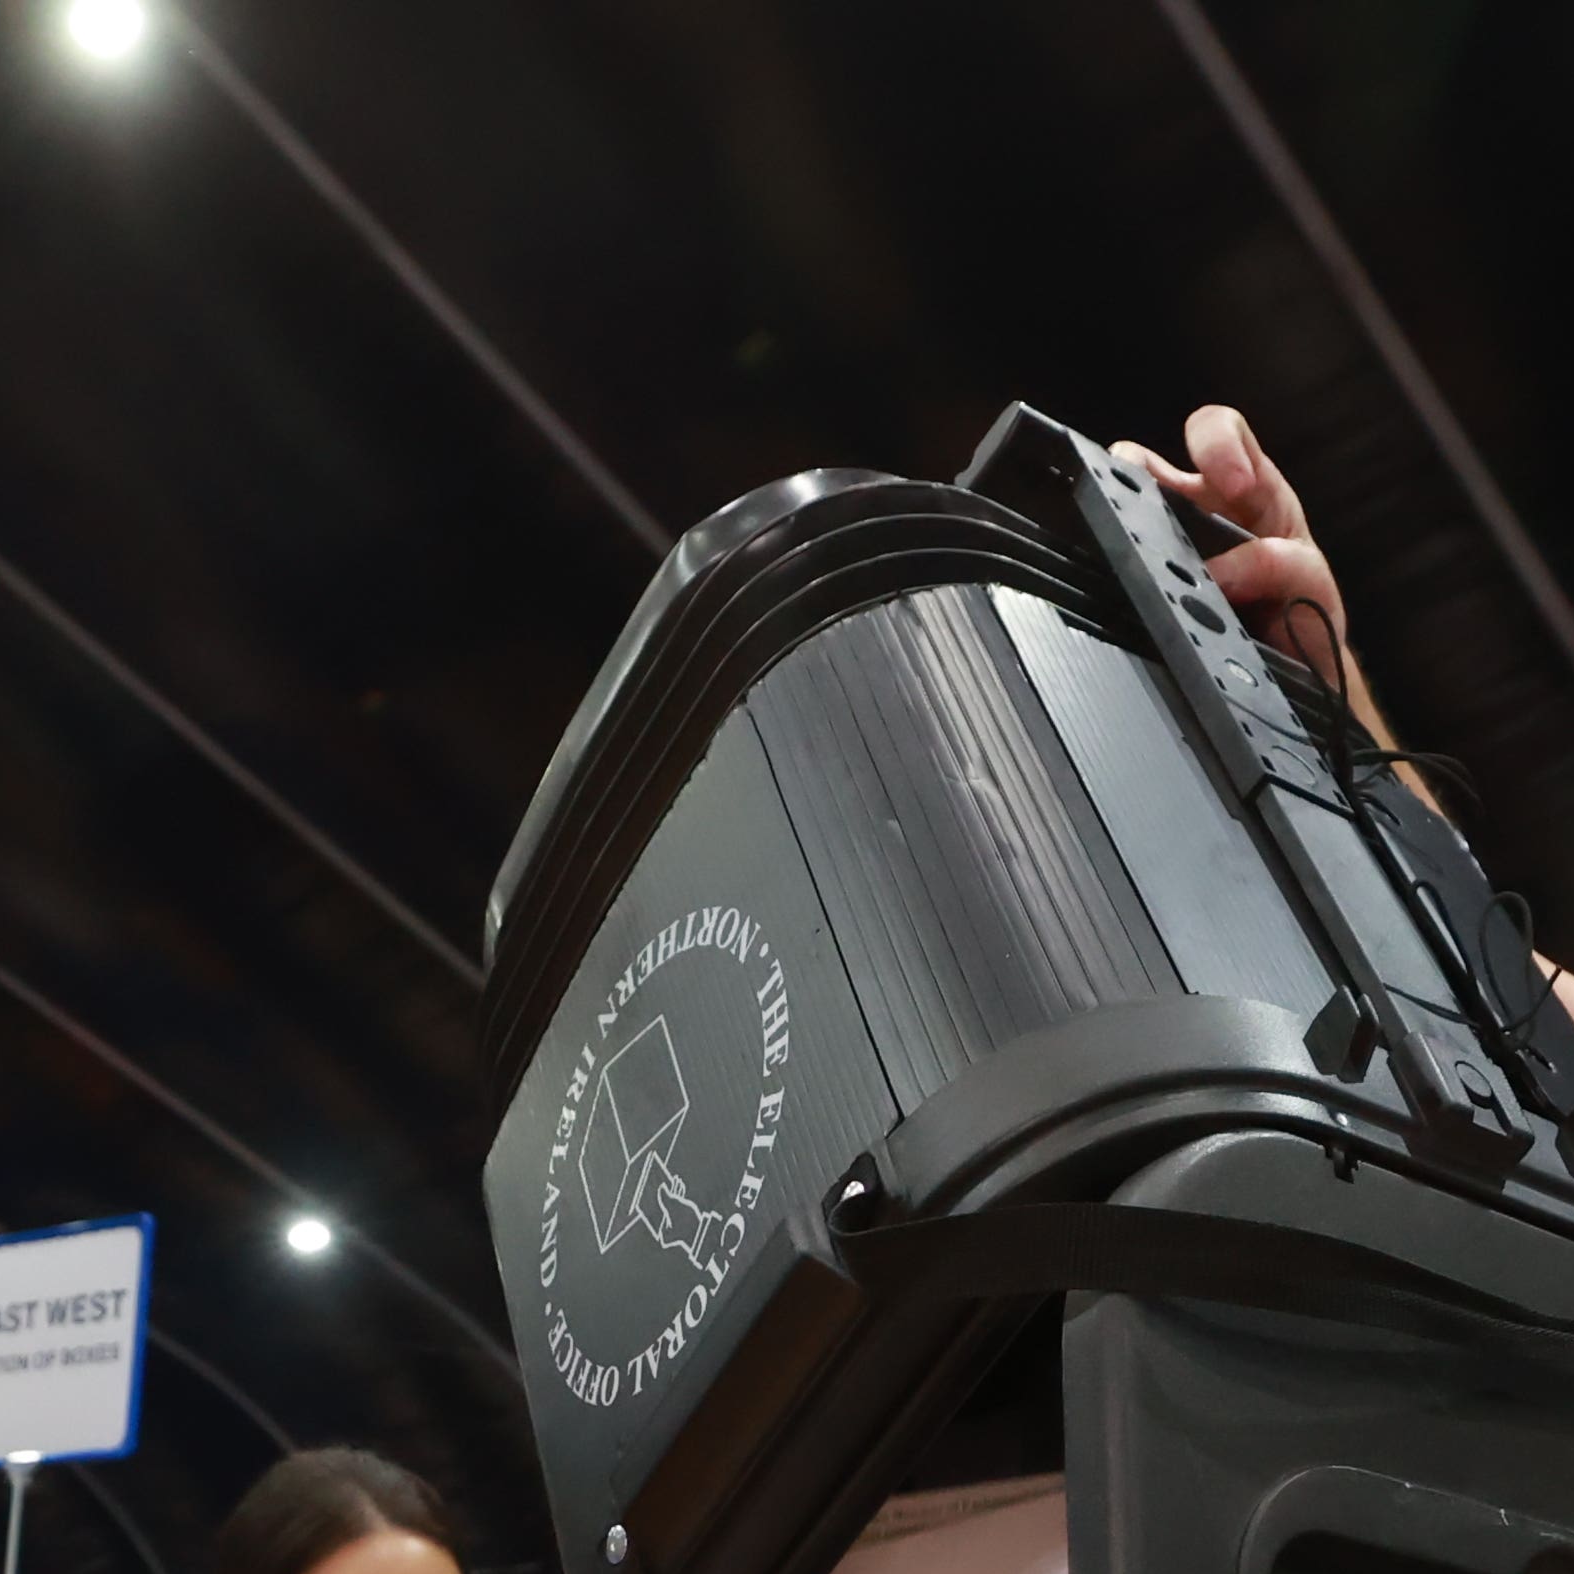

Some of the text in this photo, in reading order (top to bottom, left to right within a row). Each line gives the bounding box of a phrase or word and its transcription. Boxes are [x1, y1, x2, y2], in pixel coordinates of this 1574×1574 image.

[540, 906, 761, 1287] NORTHERN IRELAND
[548, 958, 789, 1406] THE ELECTORAL OFFICE
[45, 1288, 128, 1326] WEST
